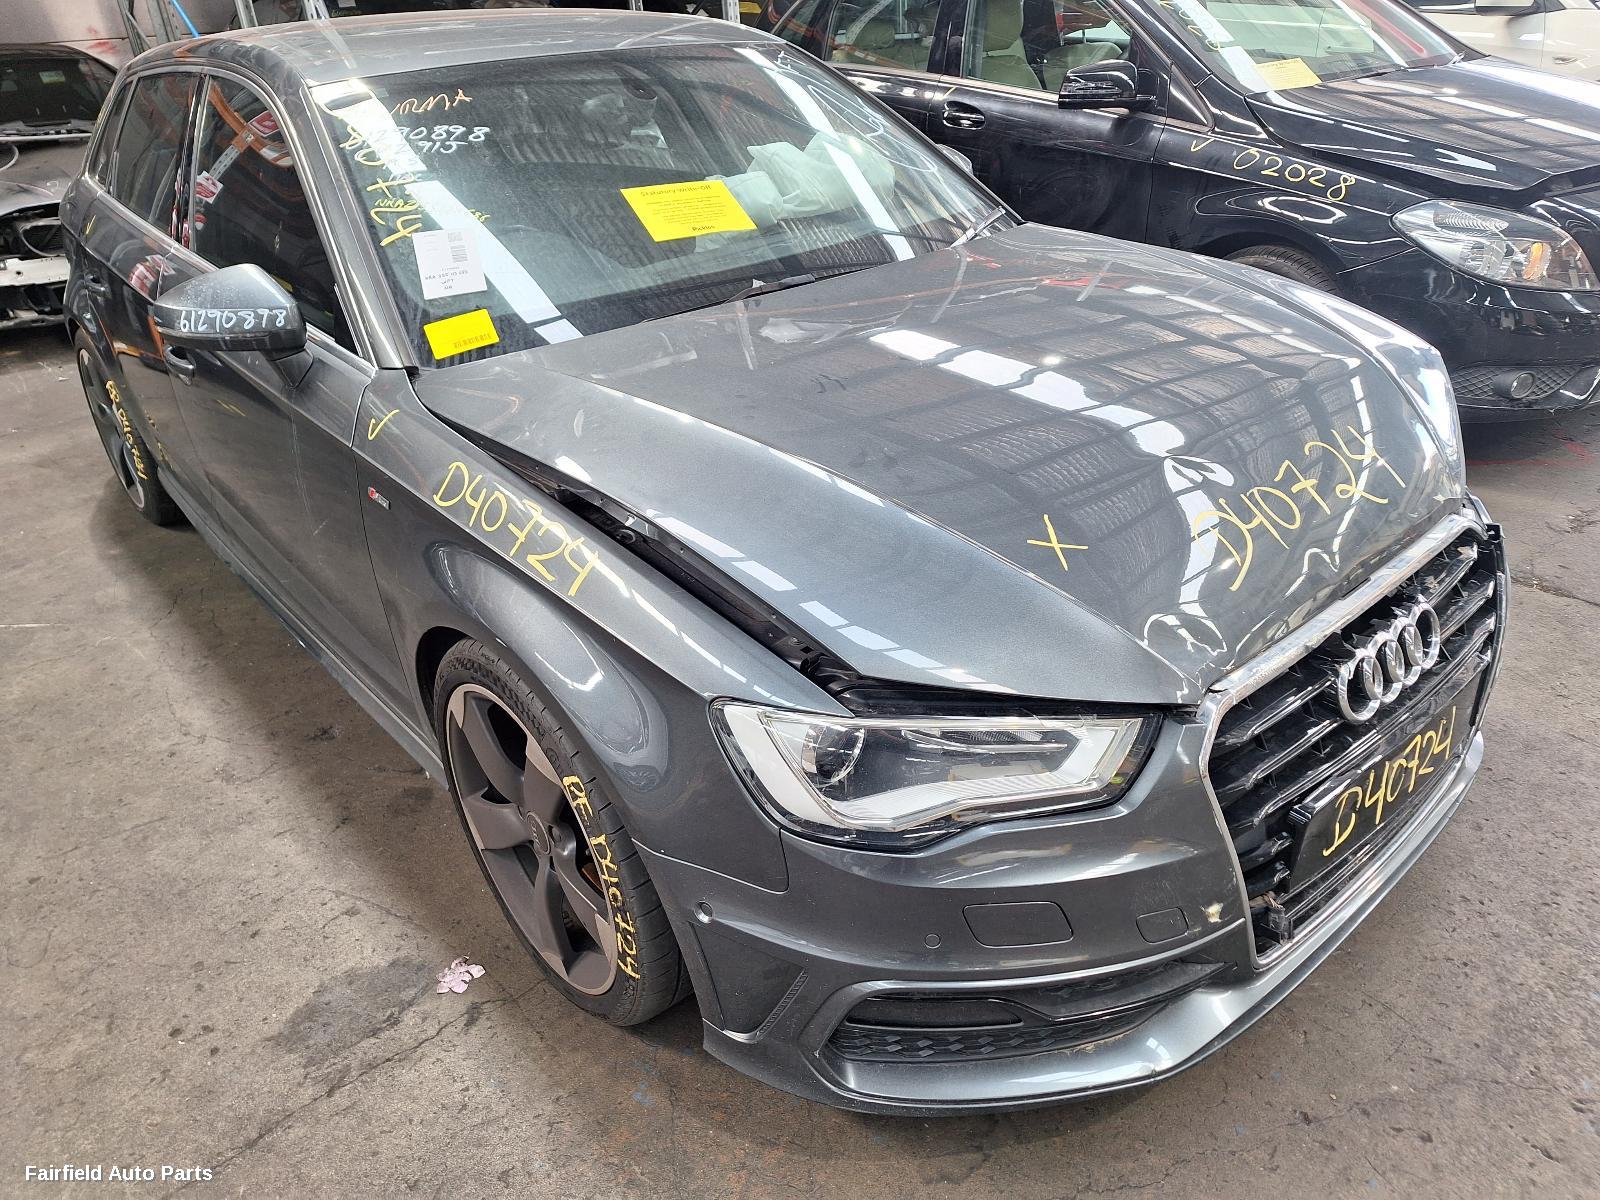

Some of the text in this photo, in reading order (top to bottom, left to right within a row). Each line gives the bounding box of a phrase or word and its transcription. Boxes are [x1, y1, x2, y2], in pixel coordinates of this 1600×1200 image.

[1233, 149, 1356, 201] 02028
[433, 461, 599, 597] D40724
[1192, 424, 1407, 592] D40724
[1322, 705, 1457, 856] D40724
[589, 833, 641, 981] D40724
